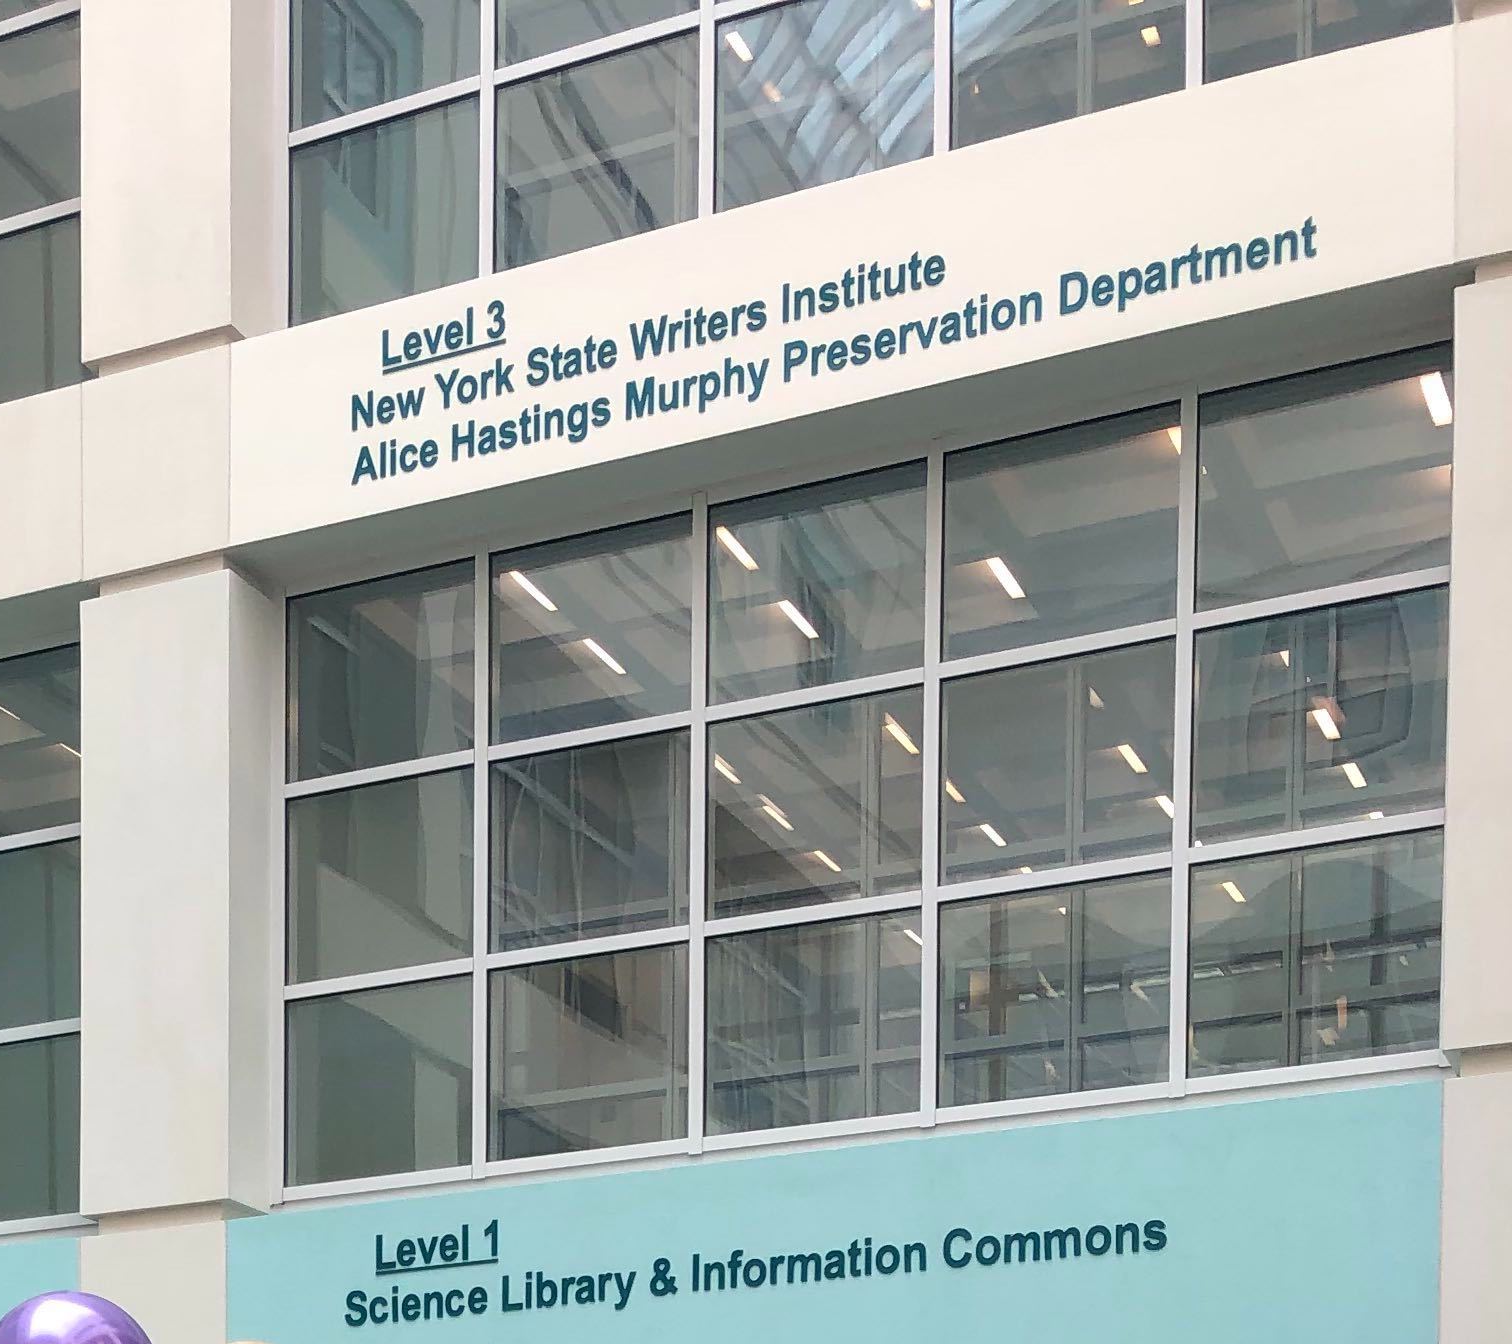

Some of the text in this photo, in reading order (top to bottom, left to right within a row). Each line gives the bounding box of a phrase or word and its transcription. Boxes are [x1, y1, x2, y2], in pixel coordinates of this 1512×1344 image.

[351, 251, 946, 432] New York State Writers Institute
[351, 216, 1317, 486] Alice Hastings Murphy Preservation Department
[382, 300, 506, 372] Level 3
[344, 1219, 1168, 1328] Science Library & Information Commons
[375, 1218, 499, 1274] Level 1
